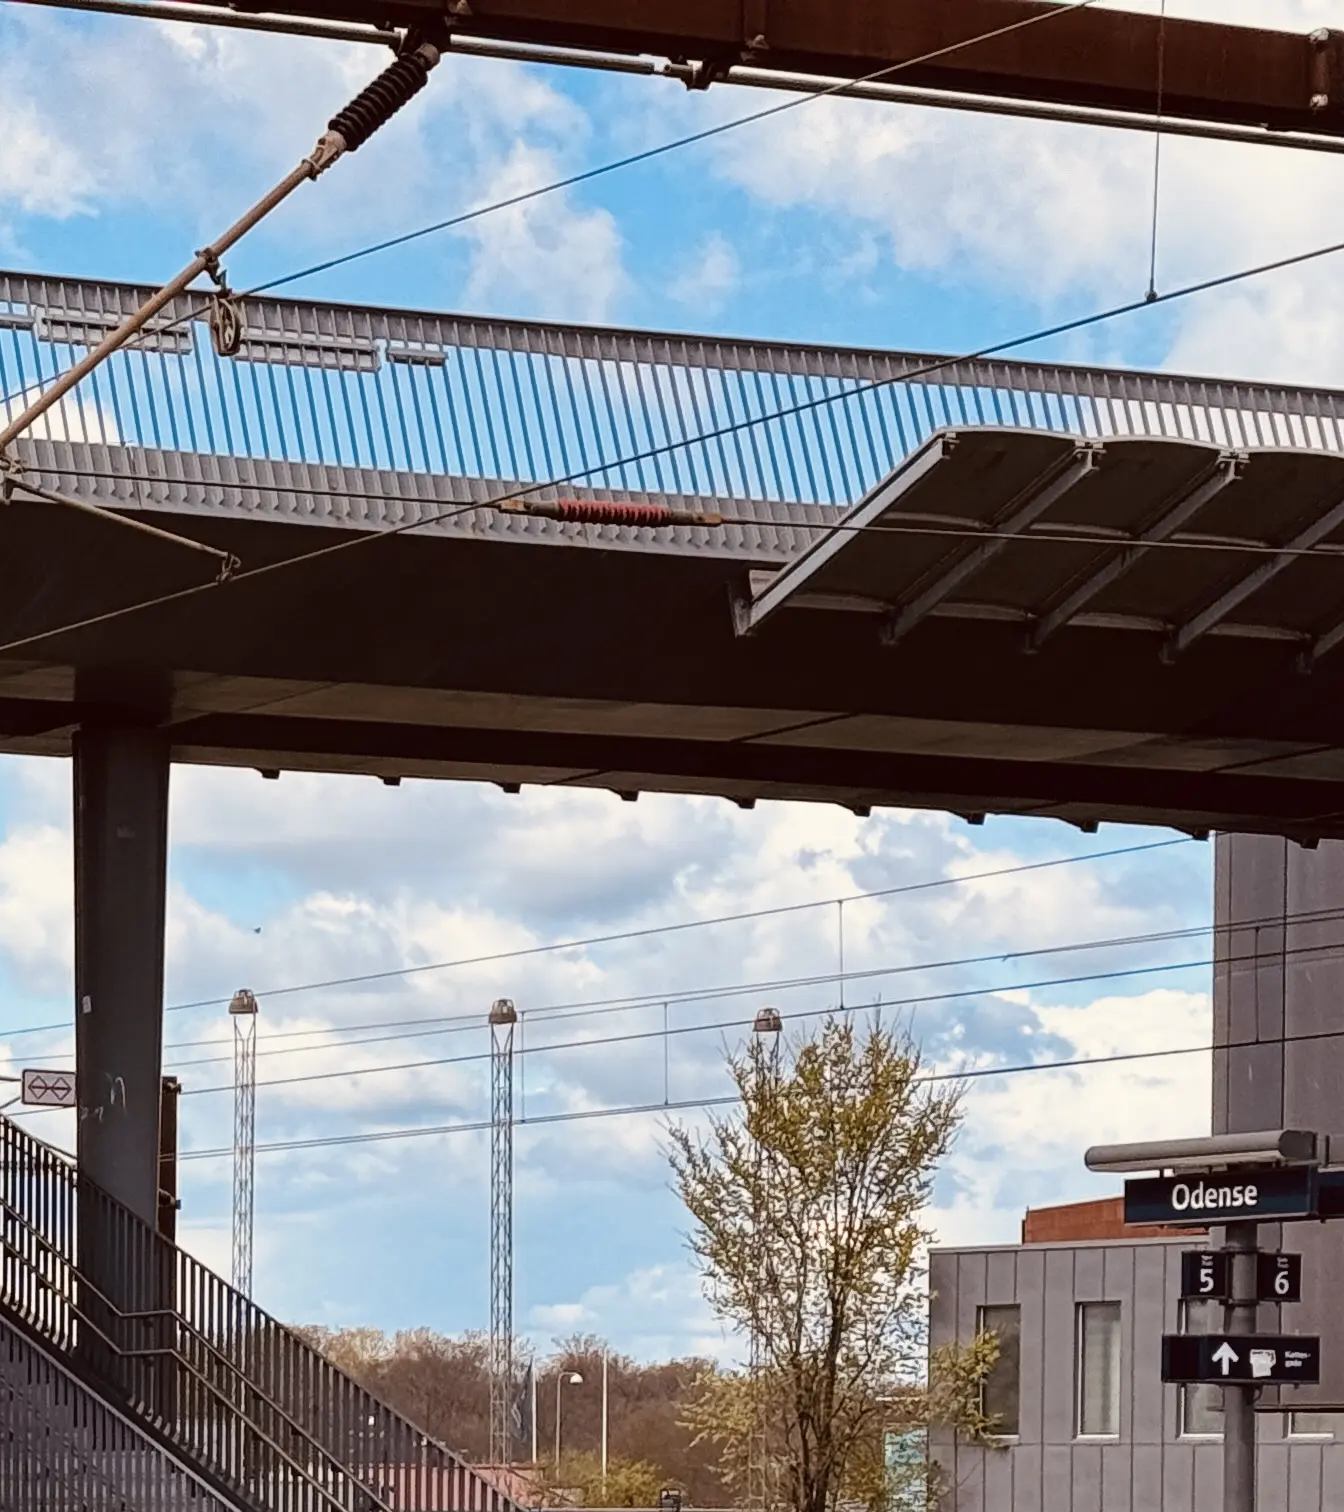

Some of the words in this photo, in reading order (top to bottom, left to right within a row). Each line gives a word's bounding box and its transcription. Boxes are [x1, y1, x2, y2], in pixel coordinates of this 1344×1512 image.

[1172, 1180, 1258, 1211] Odense
[1199, 1268, 1215, 1293] 5
[1274, 1271, 1290, 1295] 6
